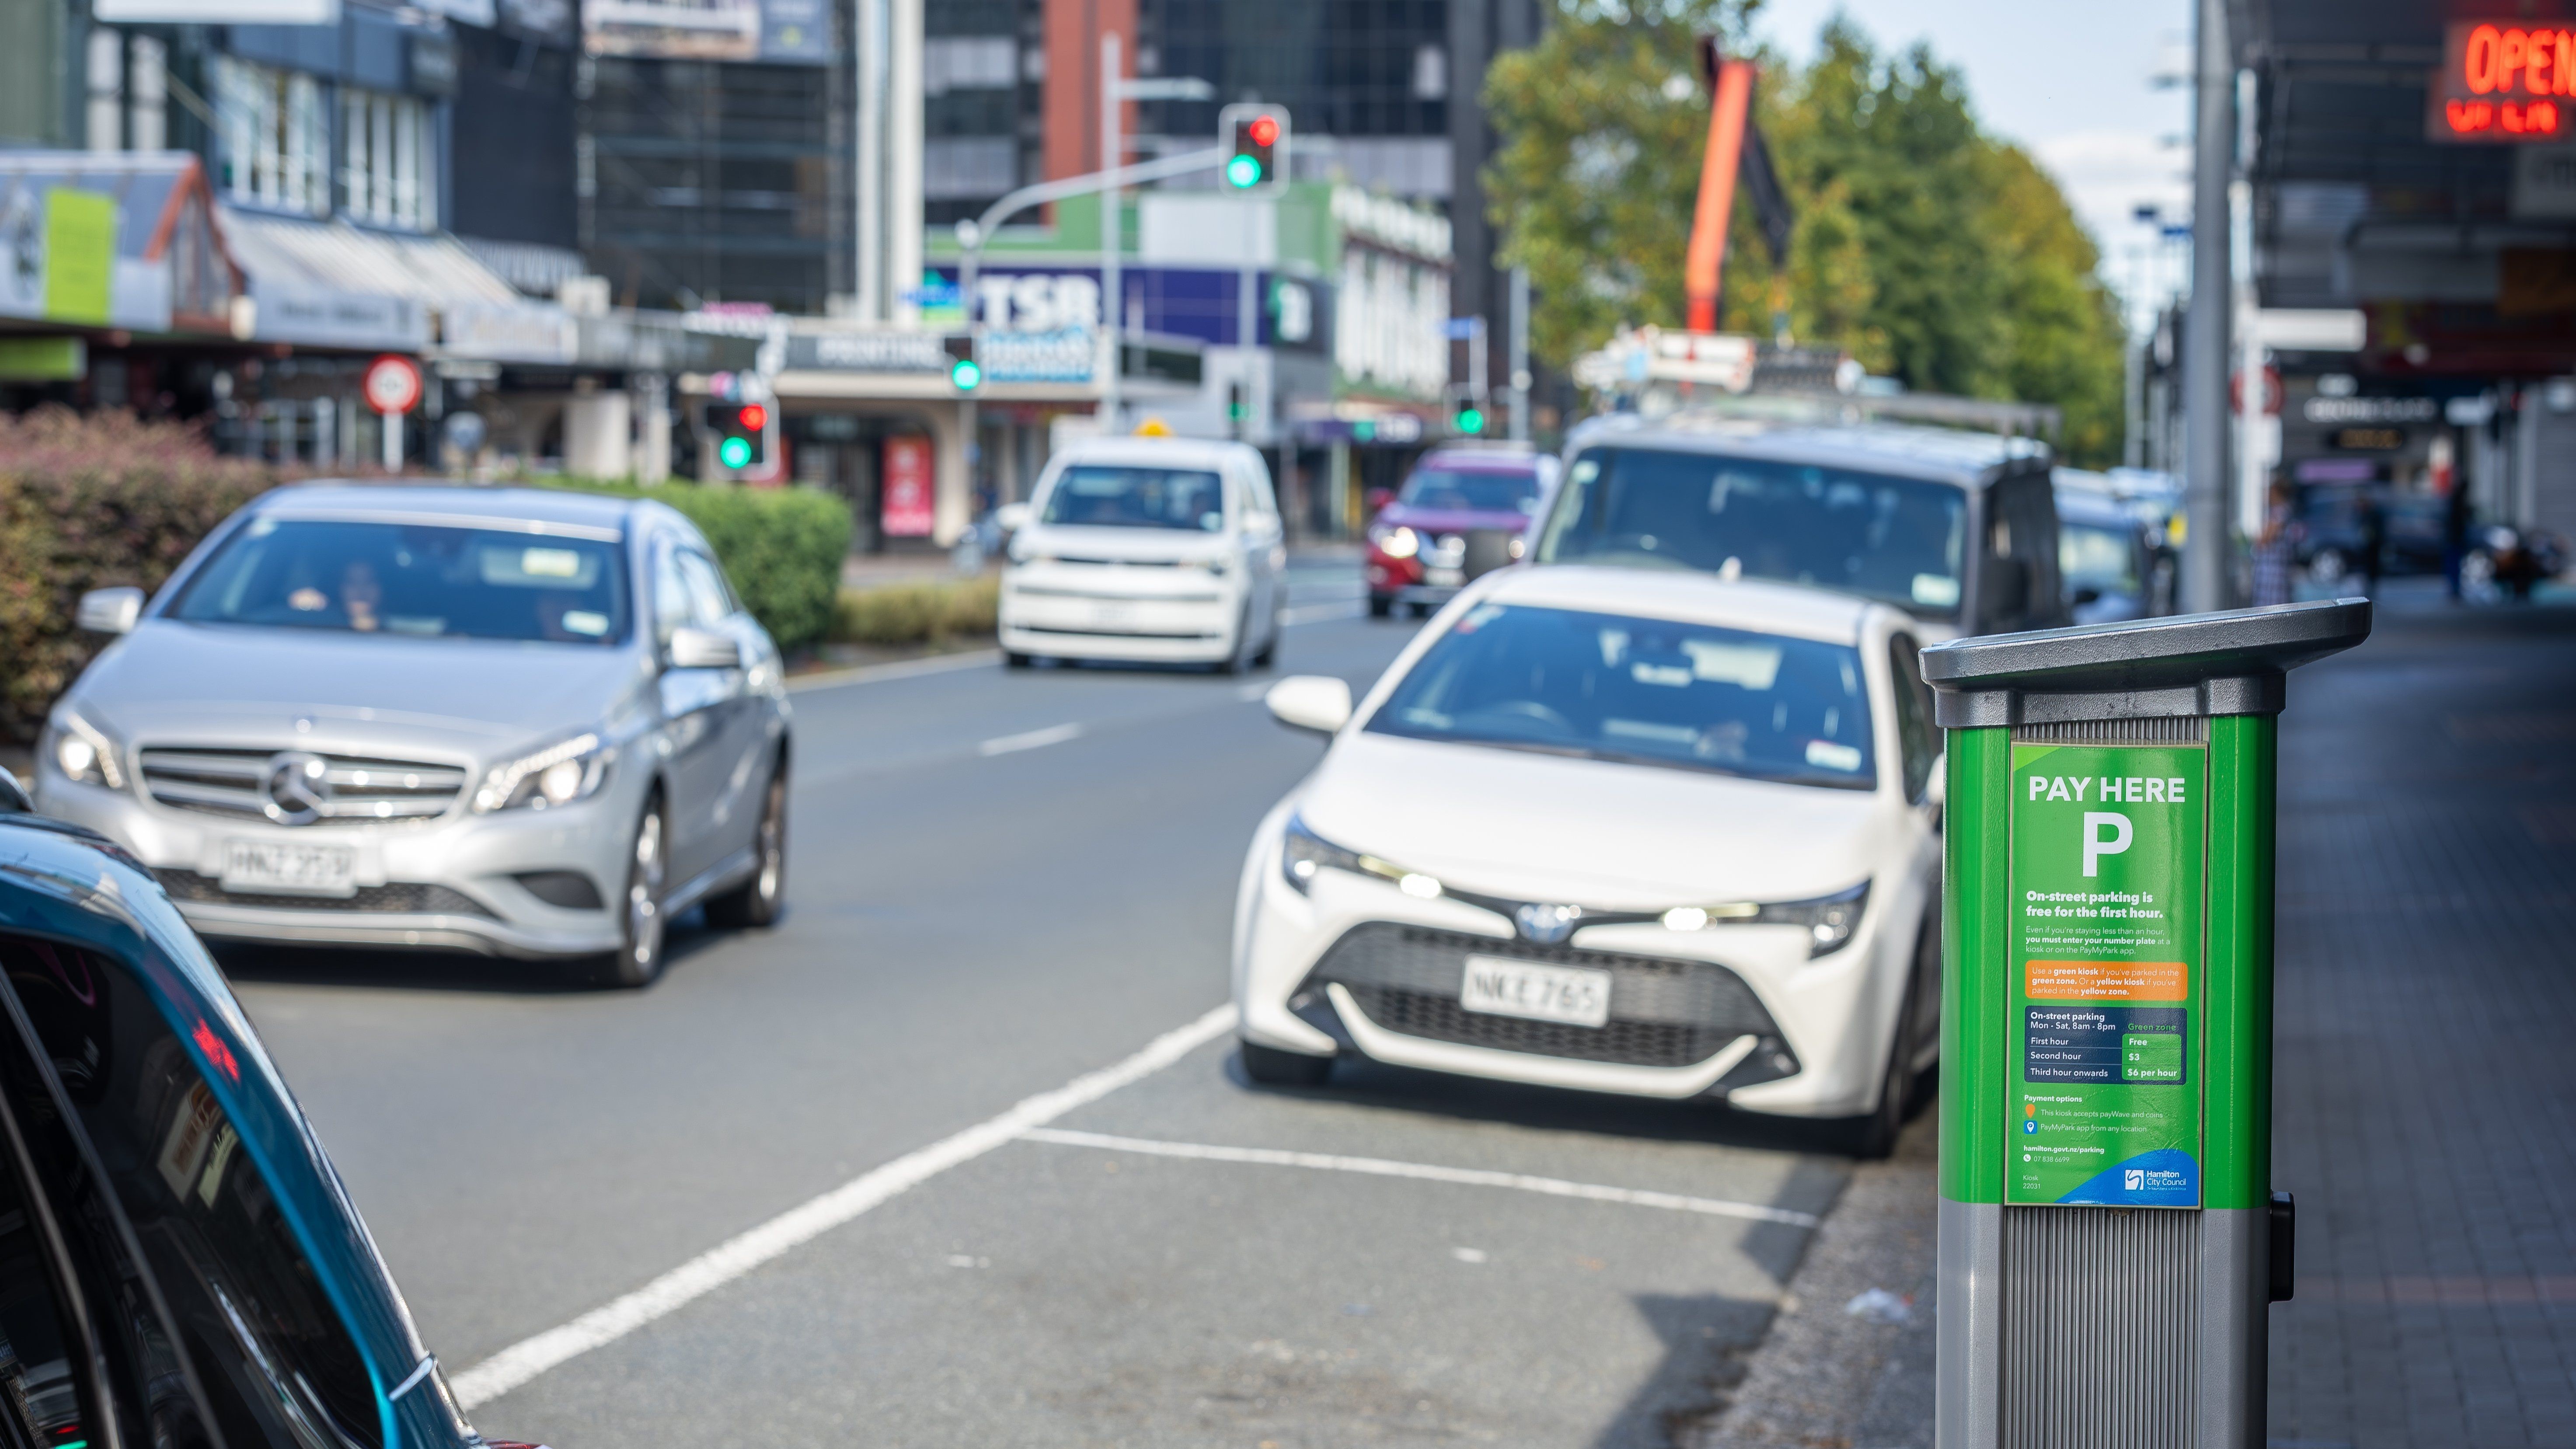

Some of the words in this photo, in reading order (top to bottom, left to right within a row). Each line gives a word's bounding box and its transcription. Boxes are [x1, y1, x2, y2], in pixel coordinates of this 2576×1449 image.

[2465, 23, 2576, 98] OPEN
[2029, 776, 2091, 801] PAY
[2100, 777, 2185, 803] HERE
[2082, 812, 2133, 877] P
[2026, 891, 2086, 902] On-street
[2089, 891, 2140, 906] parking
[2143, 891, 2153, 902] is
[2026, 905, 2052, 916] free
[2054, 906, 2074, 917] for
[2076, 906, 2098, 917] the
[2100, 906, 2126, 918] first
[2130, 907, 2163, 918] hour.
[2075, 927, 2101, 936] staying
[2136, 937, 2155, 946] plate
[2080, 946, 2118, 955] PayMyPark
[2131, 968, 2157, 977] parked
[2096, 978, 2122, 986] yellow
[2032, 987, 2057, 995] parked
[2081, 987, 2106, 996] yellow
[2072, 1013, 2105, 1022] parking
[2056, 1022, 2070, 1030] Sat,
[2097, 1022, 2116, 1032] 8pm
[2063, 1052, 2081, 1060] hour
[2129, 1053, 2140, 1061] $3
[2127, 1068, 2139, 1076] $6
[2056, 1095, 2082, 1104] options
[2040, 1123, 2074, 1132] PayMyPark
[2023, 1145, 2105, 1155] hamilton.govt.nz/parking
[2147, 1178, 2161, 1187] City
